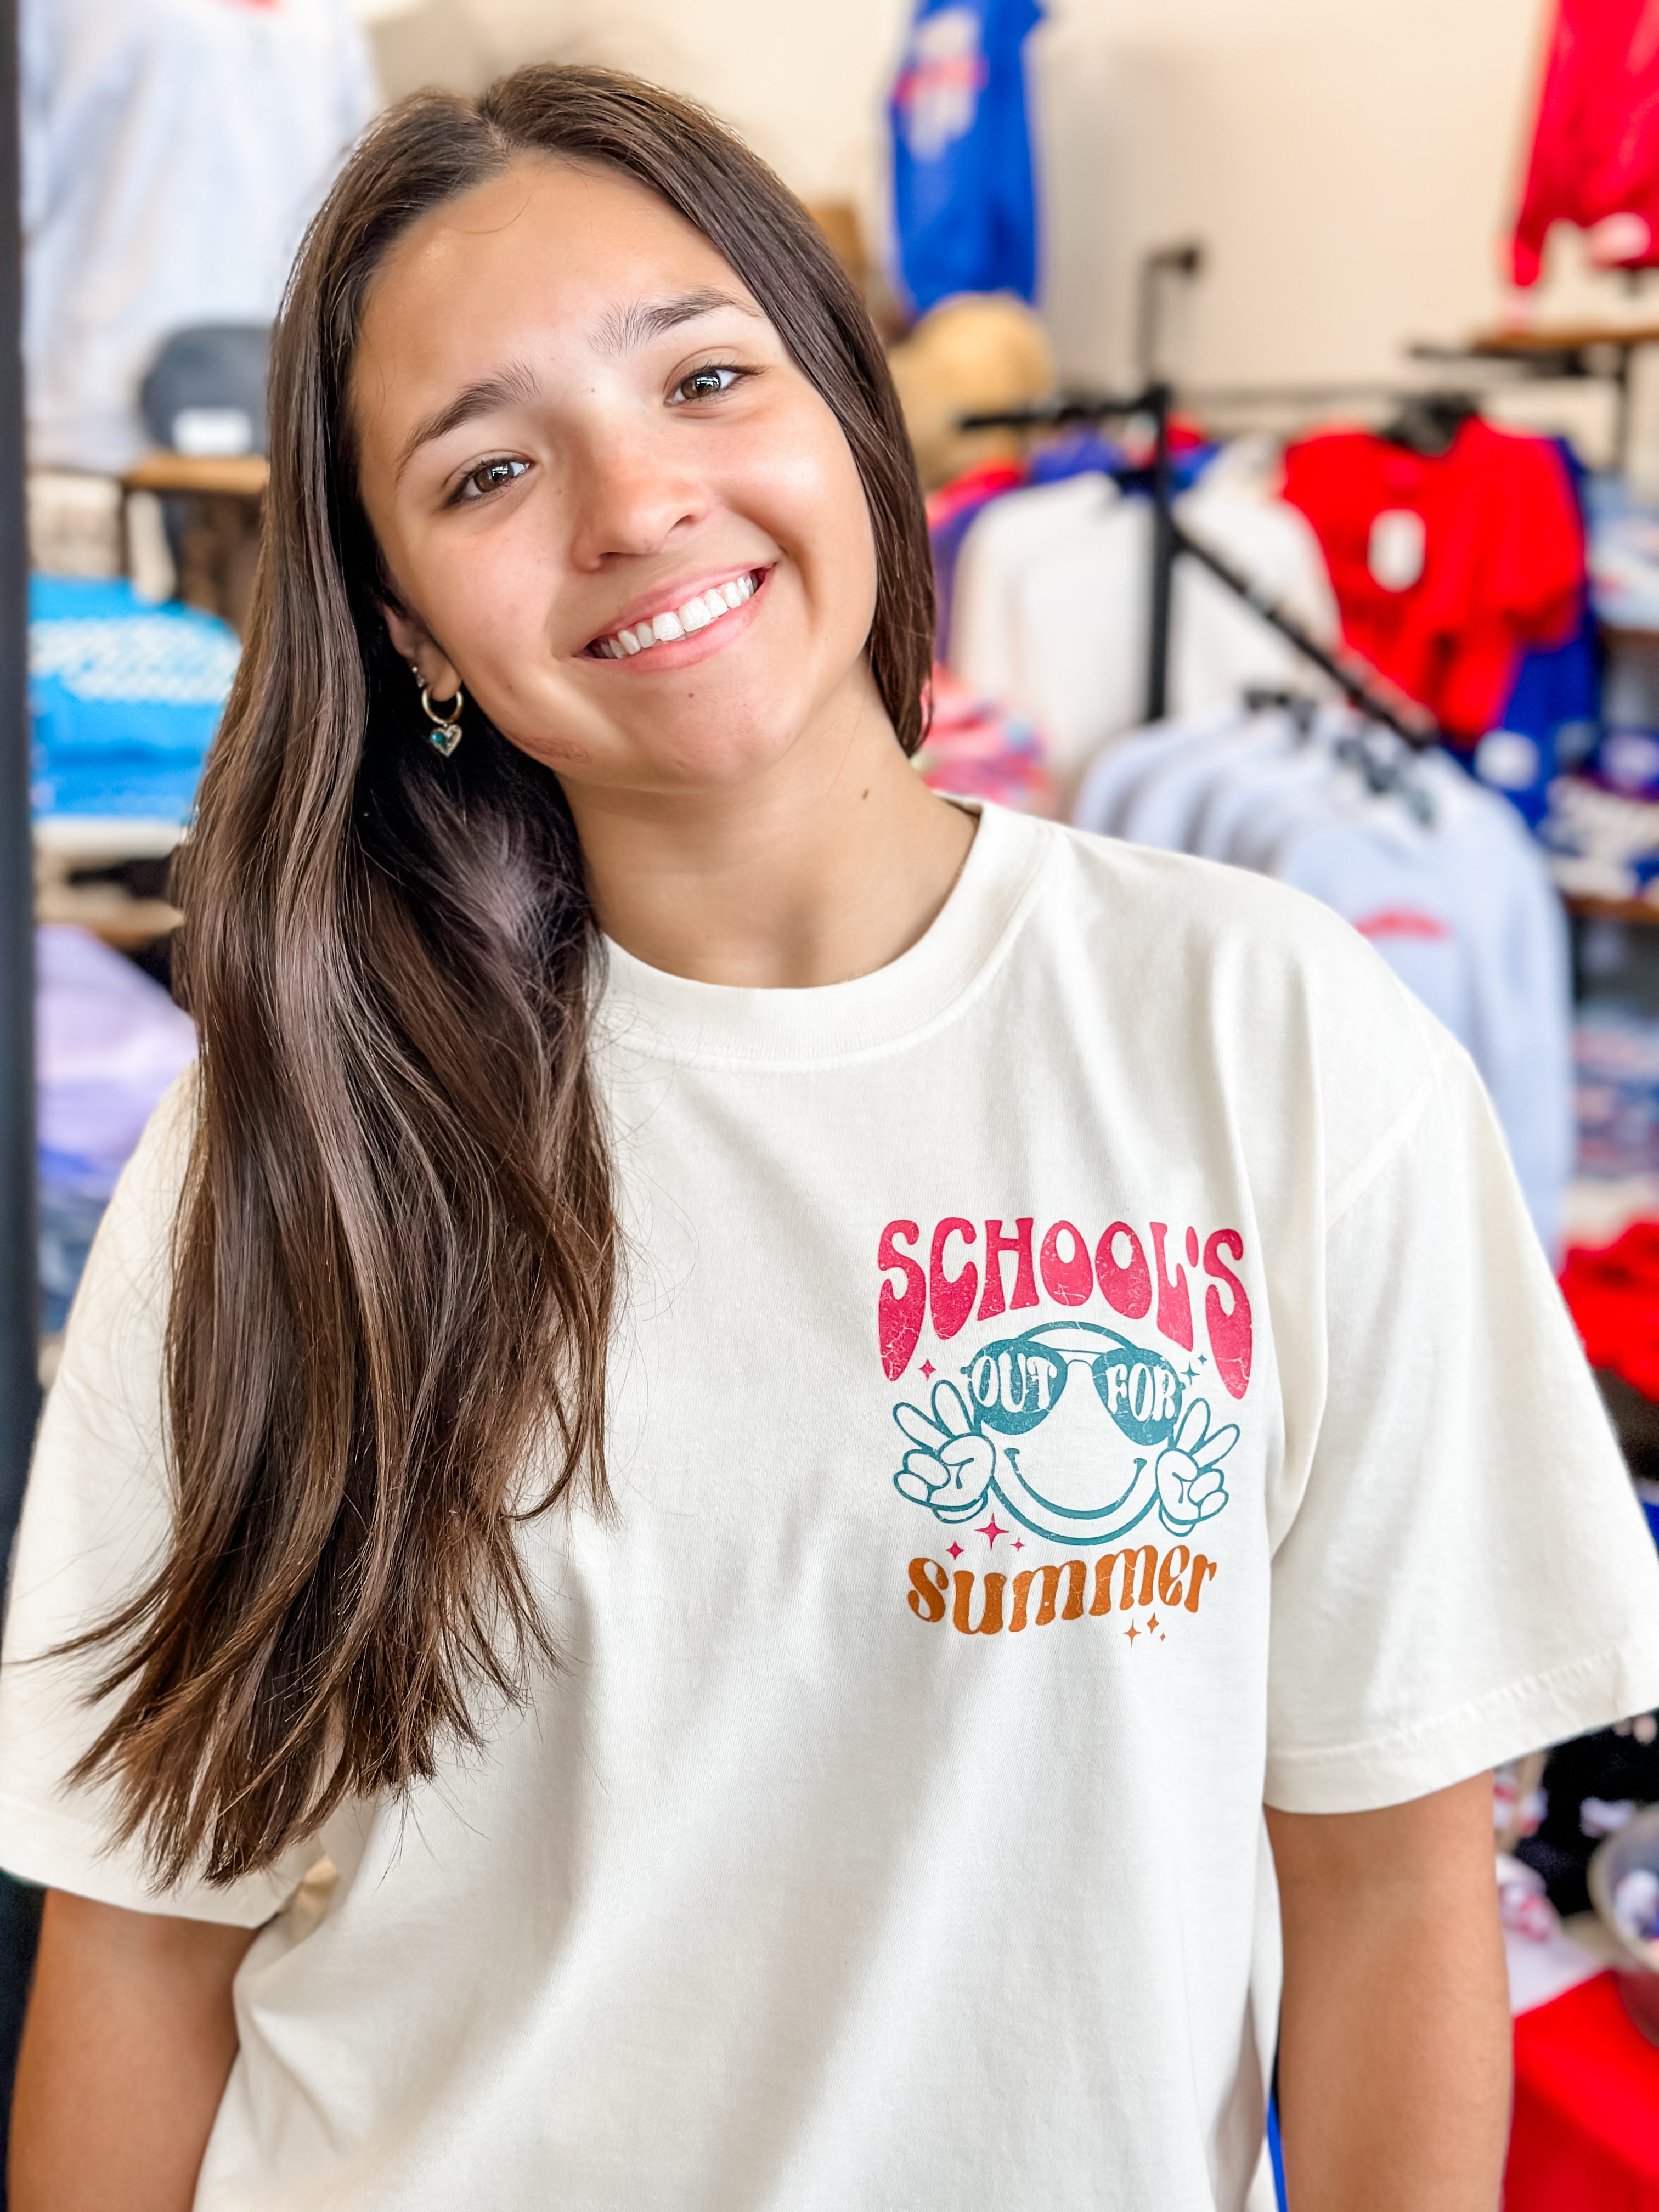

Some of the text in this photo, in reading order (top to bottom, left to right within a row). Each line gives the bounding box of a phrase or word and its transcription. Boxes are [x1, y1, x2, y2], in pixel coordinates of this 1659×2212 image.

[878, 1217, 1253, 1400] SCHOOL'S
[973, 1352, 1178, 1423] OUT FOR
